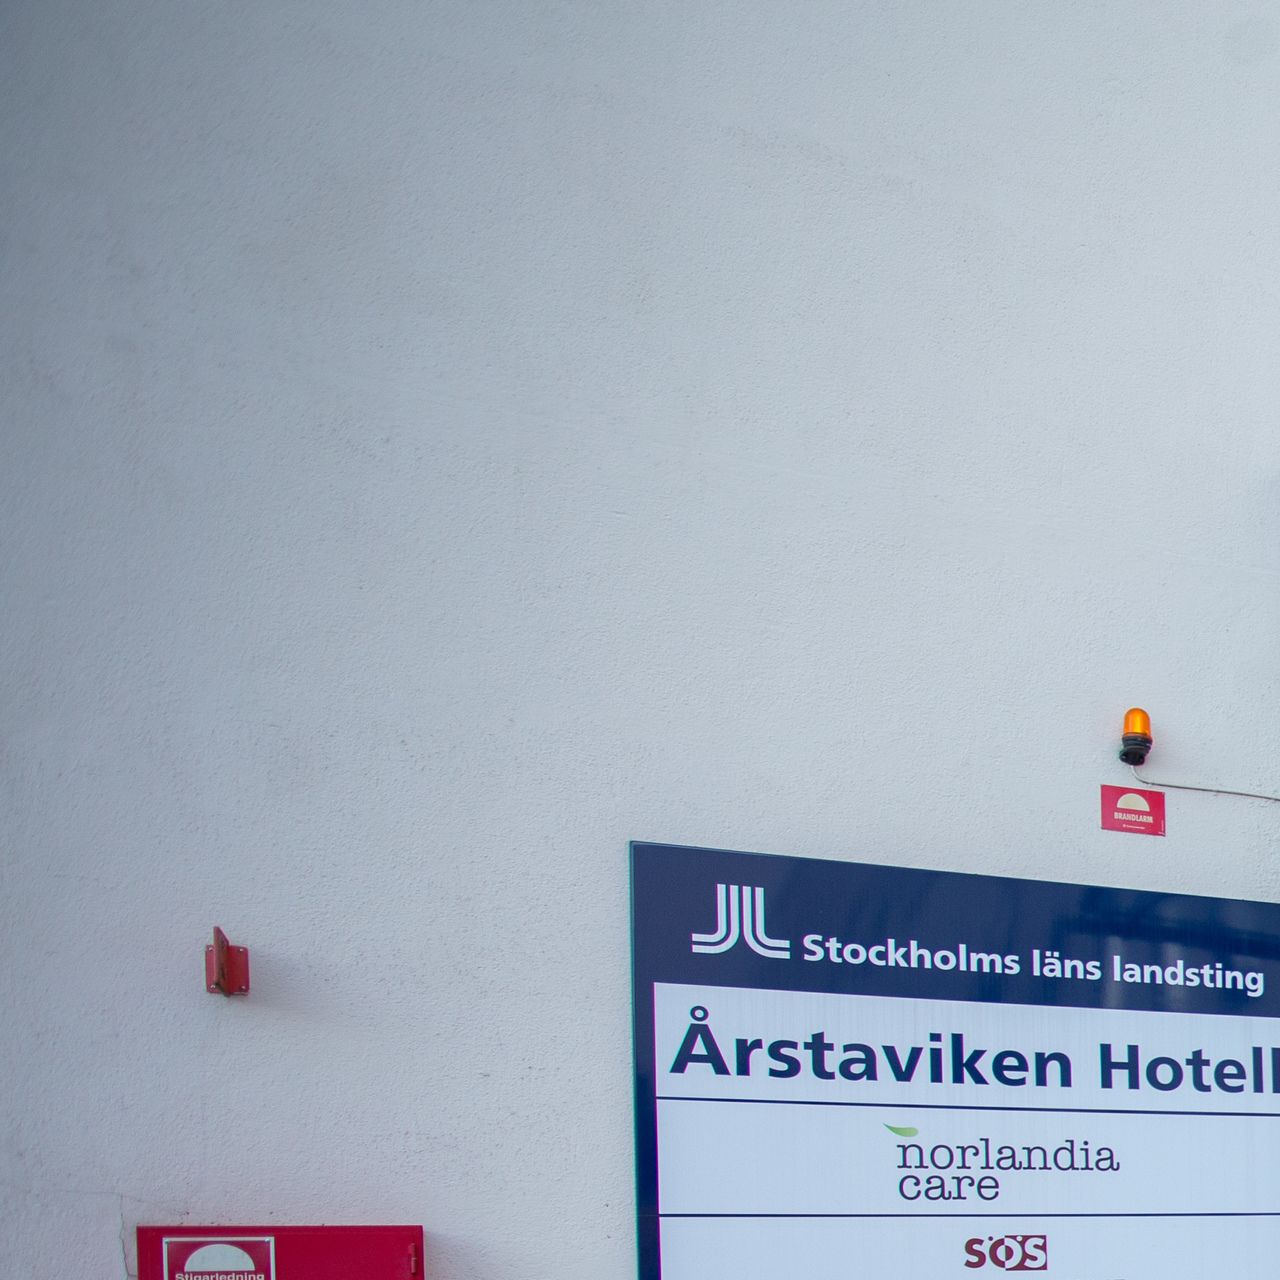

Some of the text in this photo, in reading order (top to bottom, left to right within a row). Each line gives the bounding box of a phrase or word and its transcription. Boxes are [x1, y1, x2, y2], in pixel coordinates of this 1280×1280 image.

[1114, 812, 1153, 823] BRANDLARM
[802, 933, 1265, 998] Stockholms läns landsting
[668, 1004, 1074, 1089] Årstaviken
[896, 1137, 1121, 1172] norlandia
[898, 1174, 1000, 1201] care
[963, 1234, 1048, 1271] SÖS
